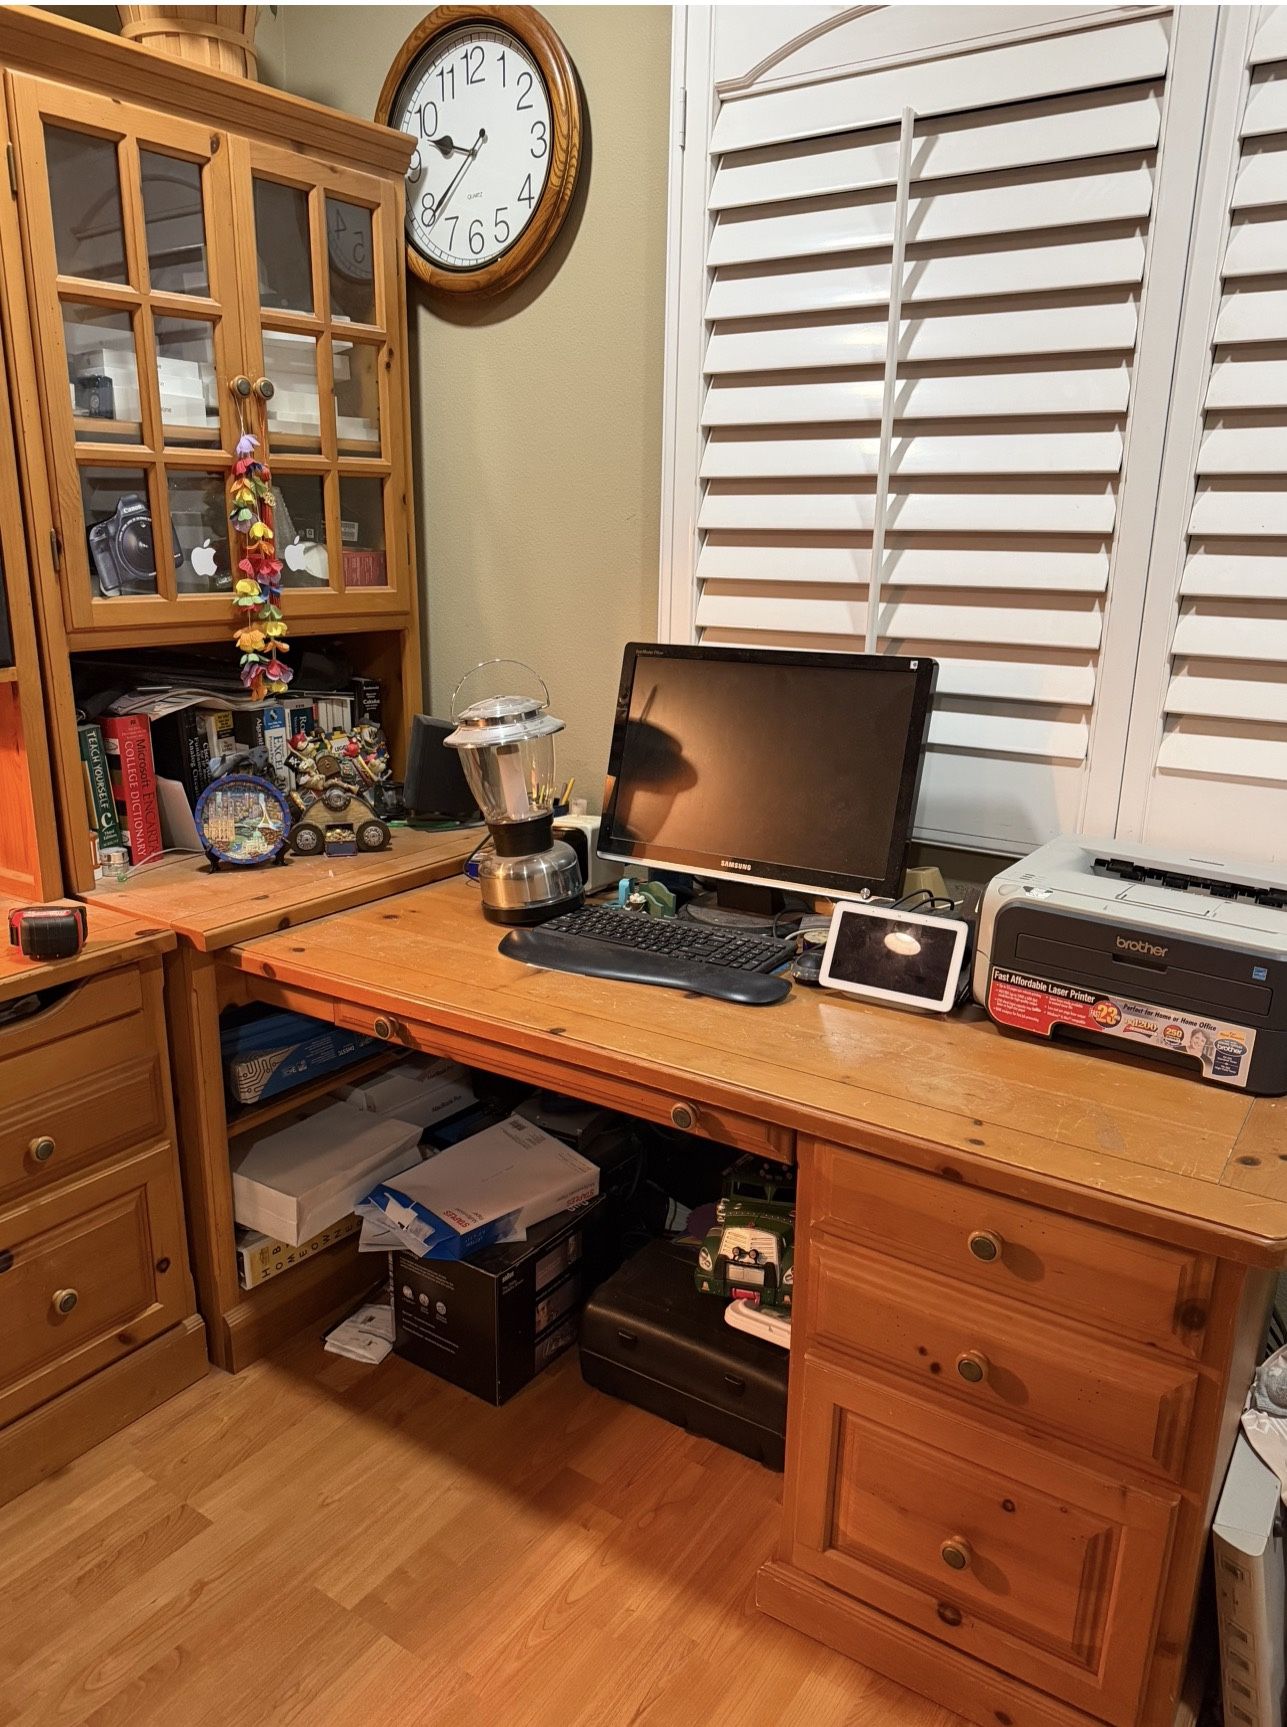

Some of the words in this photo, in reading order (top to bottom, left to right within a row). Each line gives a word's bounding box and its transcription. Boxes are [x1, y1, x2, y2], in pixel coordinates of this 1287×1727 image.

[436, 63, 455, 102] 11
[460, 46, 486, 85] 12
[496, 50, 506, 88] 1
[516, 71, 534, 111] 2
[414, 101, 439, 139] 10
[530, 120, 547, 159] 3
[408, 148, 422, 184] 9
[517, 173, 535, 209] 4
[421, 192, 436, 228] 8
[494, 207, 510, 243] 5
[445, 216, 459, 251] 7
[468, 219, 485, 255] 6
[123, 504, 144, 514] Canon
[86, 731, 101, 764] TEACH
[136, 738, 149, 791] Microsoft
[93, 764, 109, 809] YOURSELF
[124, 741, 138, 790] COLLEGE
[131, 792, 146, 856] DICTIONARY
[101, 812, 115, 832] C
[720, 860, 752, 871] SAMSUNG
[1116, 935, 1169, 958] brother
[994, 970, 1009, 982] Fast
[1010, 974, 1047, 992] Affordable
[1048, 984, 1069, 998] Laser
[1069, 989, 1095, 1004] Printer
[1097, 1004, 1118, 1025] 23
[1123, 1003, 1144, 1015] Perfect
[1145, 1008, 1153, 1016] for
[1154, 1011, 1171, 1020] Home
[1180, 1017, 1197, 1027] Home
[1199, 1021, 1217, 1031] Office
[1166, 1027, 1183, 1038] 250
[1216, 1043, 1242, 1054] brother
[443, 1210, 470, 1228] STAPLES
